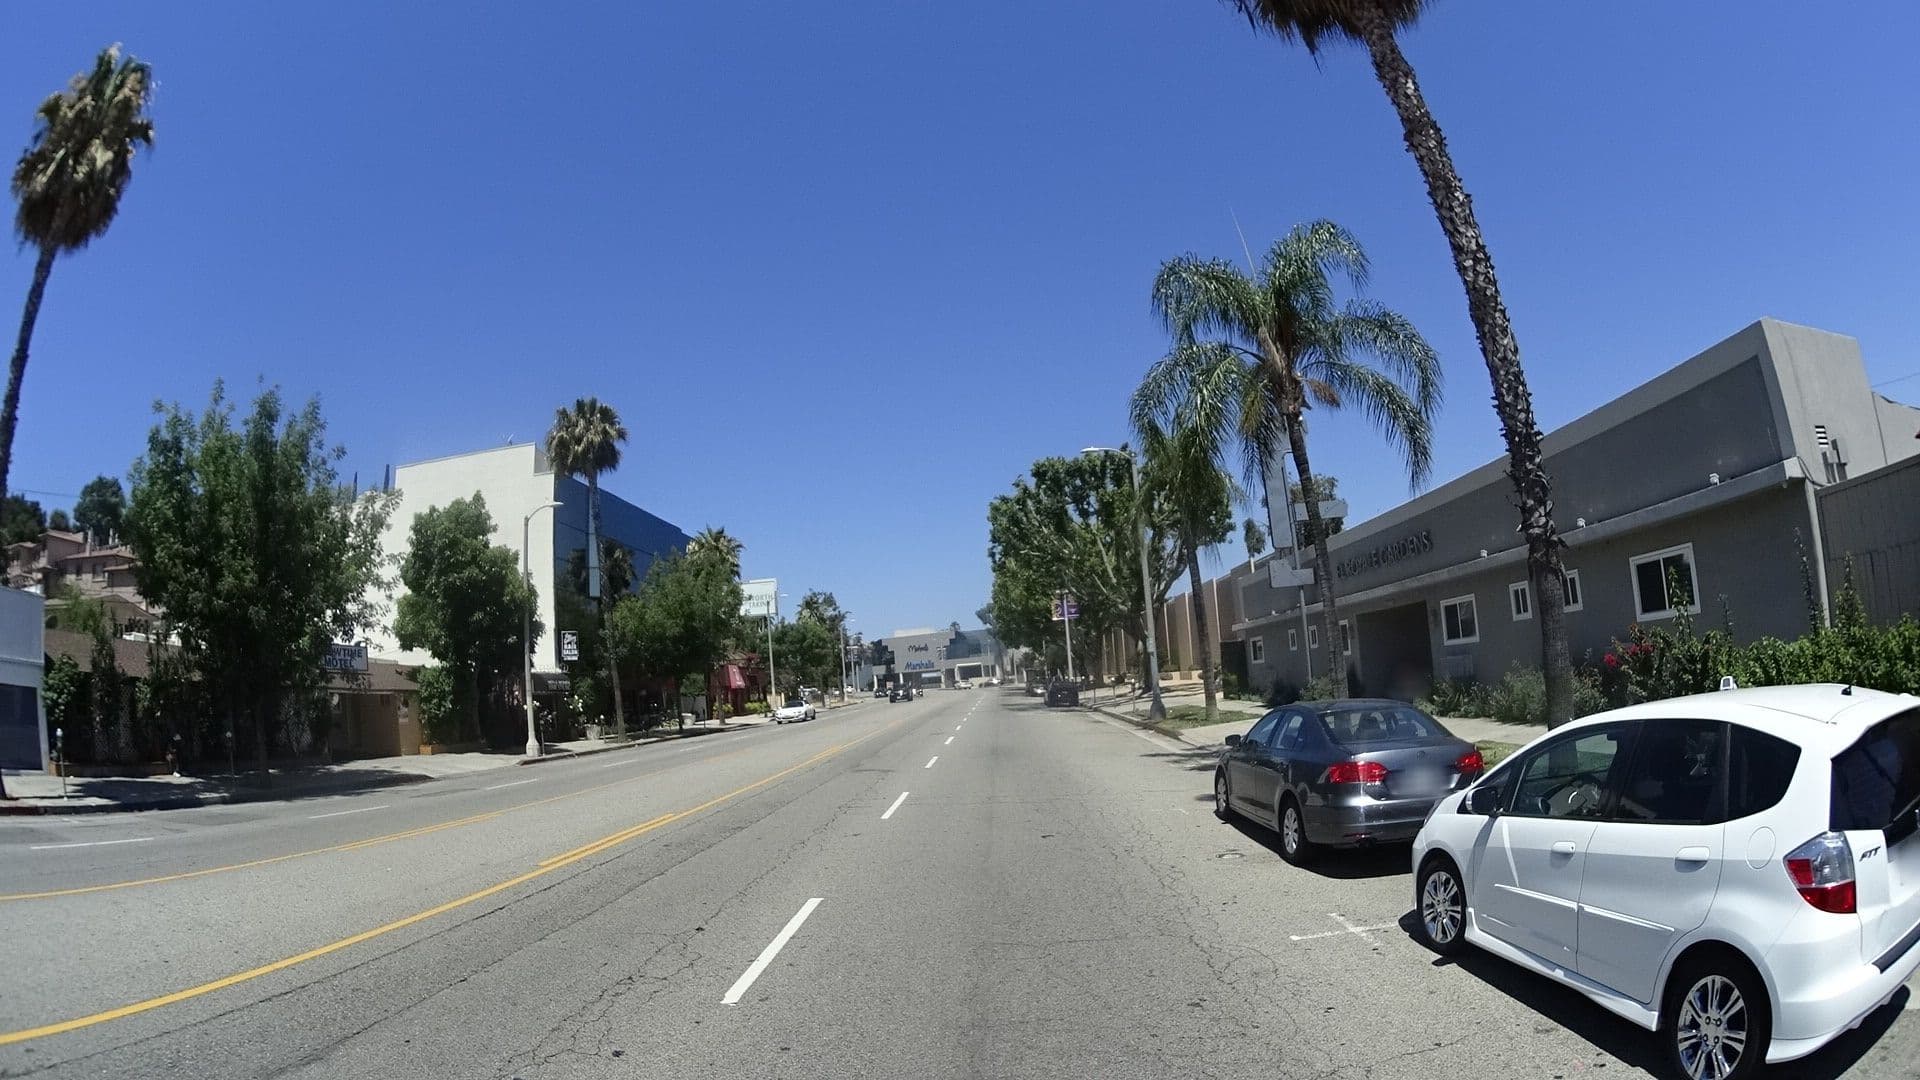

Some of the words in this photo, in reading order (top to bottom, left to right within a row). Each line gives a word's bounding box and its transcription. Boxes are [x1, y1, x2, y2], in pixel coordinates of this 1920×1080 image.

[1382, 528, 1434, 568] GARDENS
[324, 656, 354, 668] MOTEL
[904, 659, 935, 671] Marshalls
